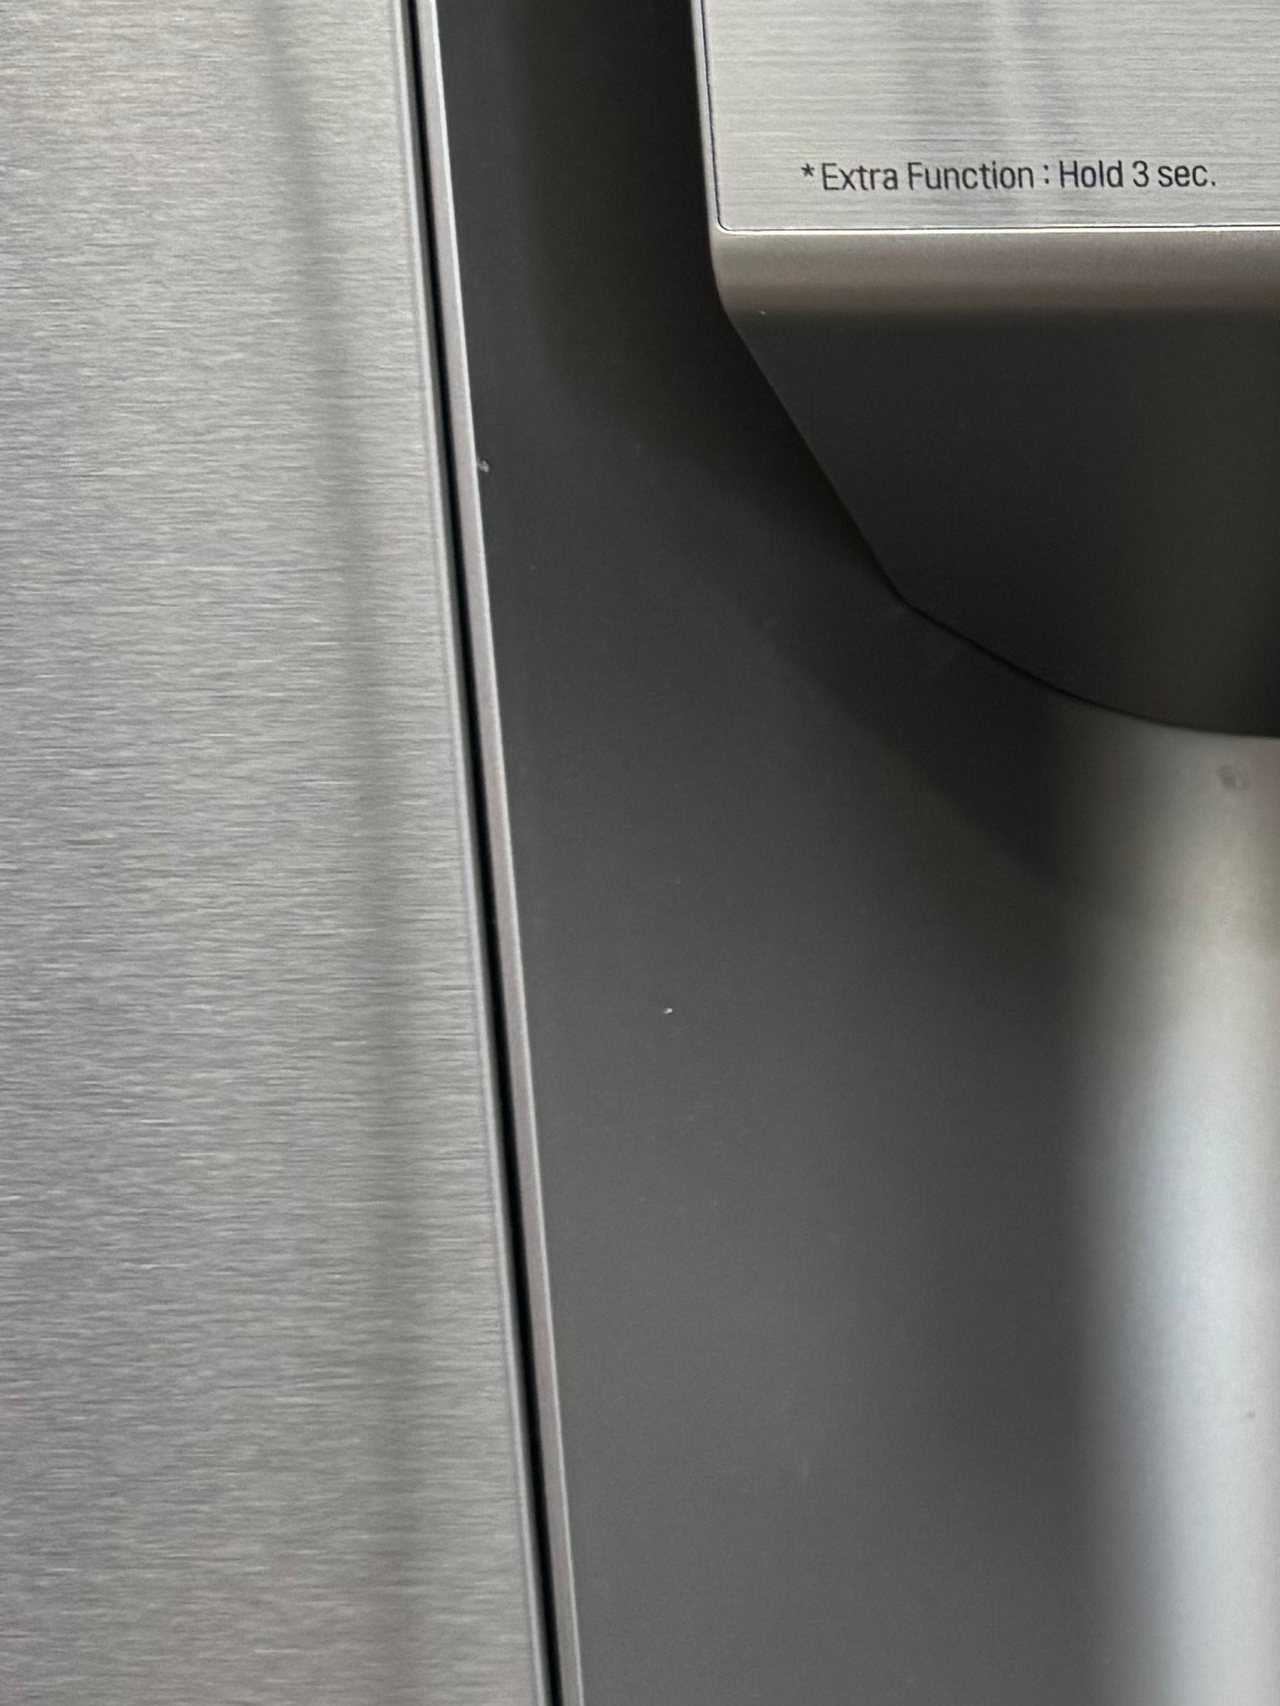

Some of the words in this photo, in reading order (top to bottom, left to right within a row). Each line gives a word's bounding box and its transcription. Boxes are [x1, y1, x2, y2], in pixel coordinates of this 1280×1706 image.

[1058, 159, 1124, 189] Hold
[1131, 159, 1150, 188] 3
[1157, 164, 1216, 188] sec.
